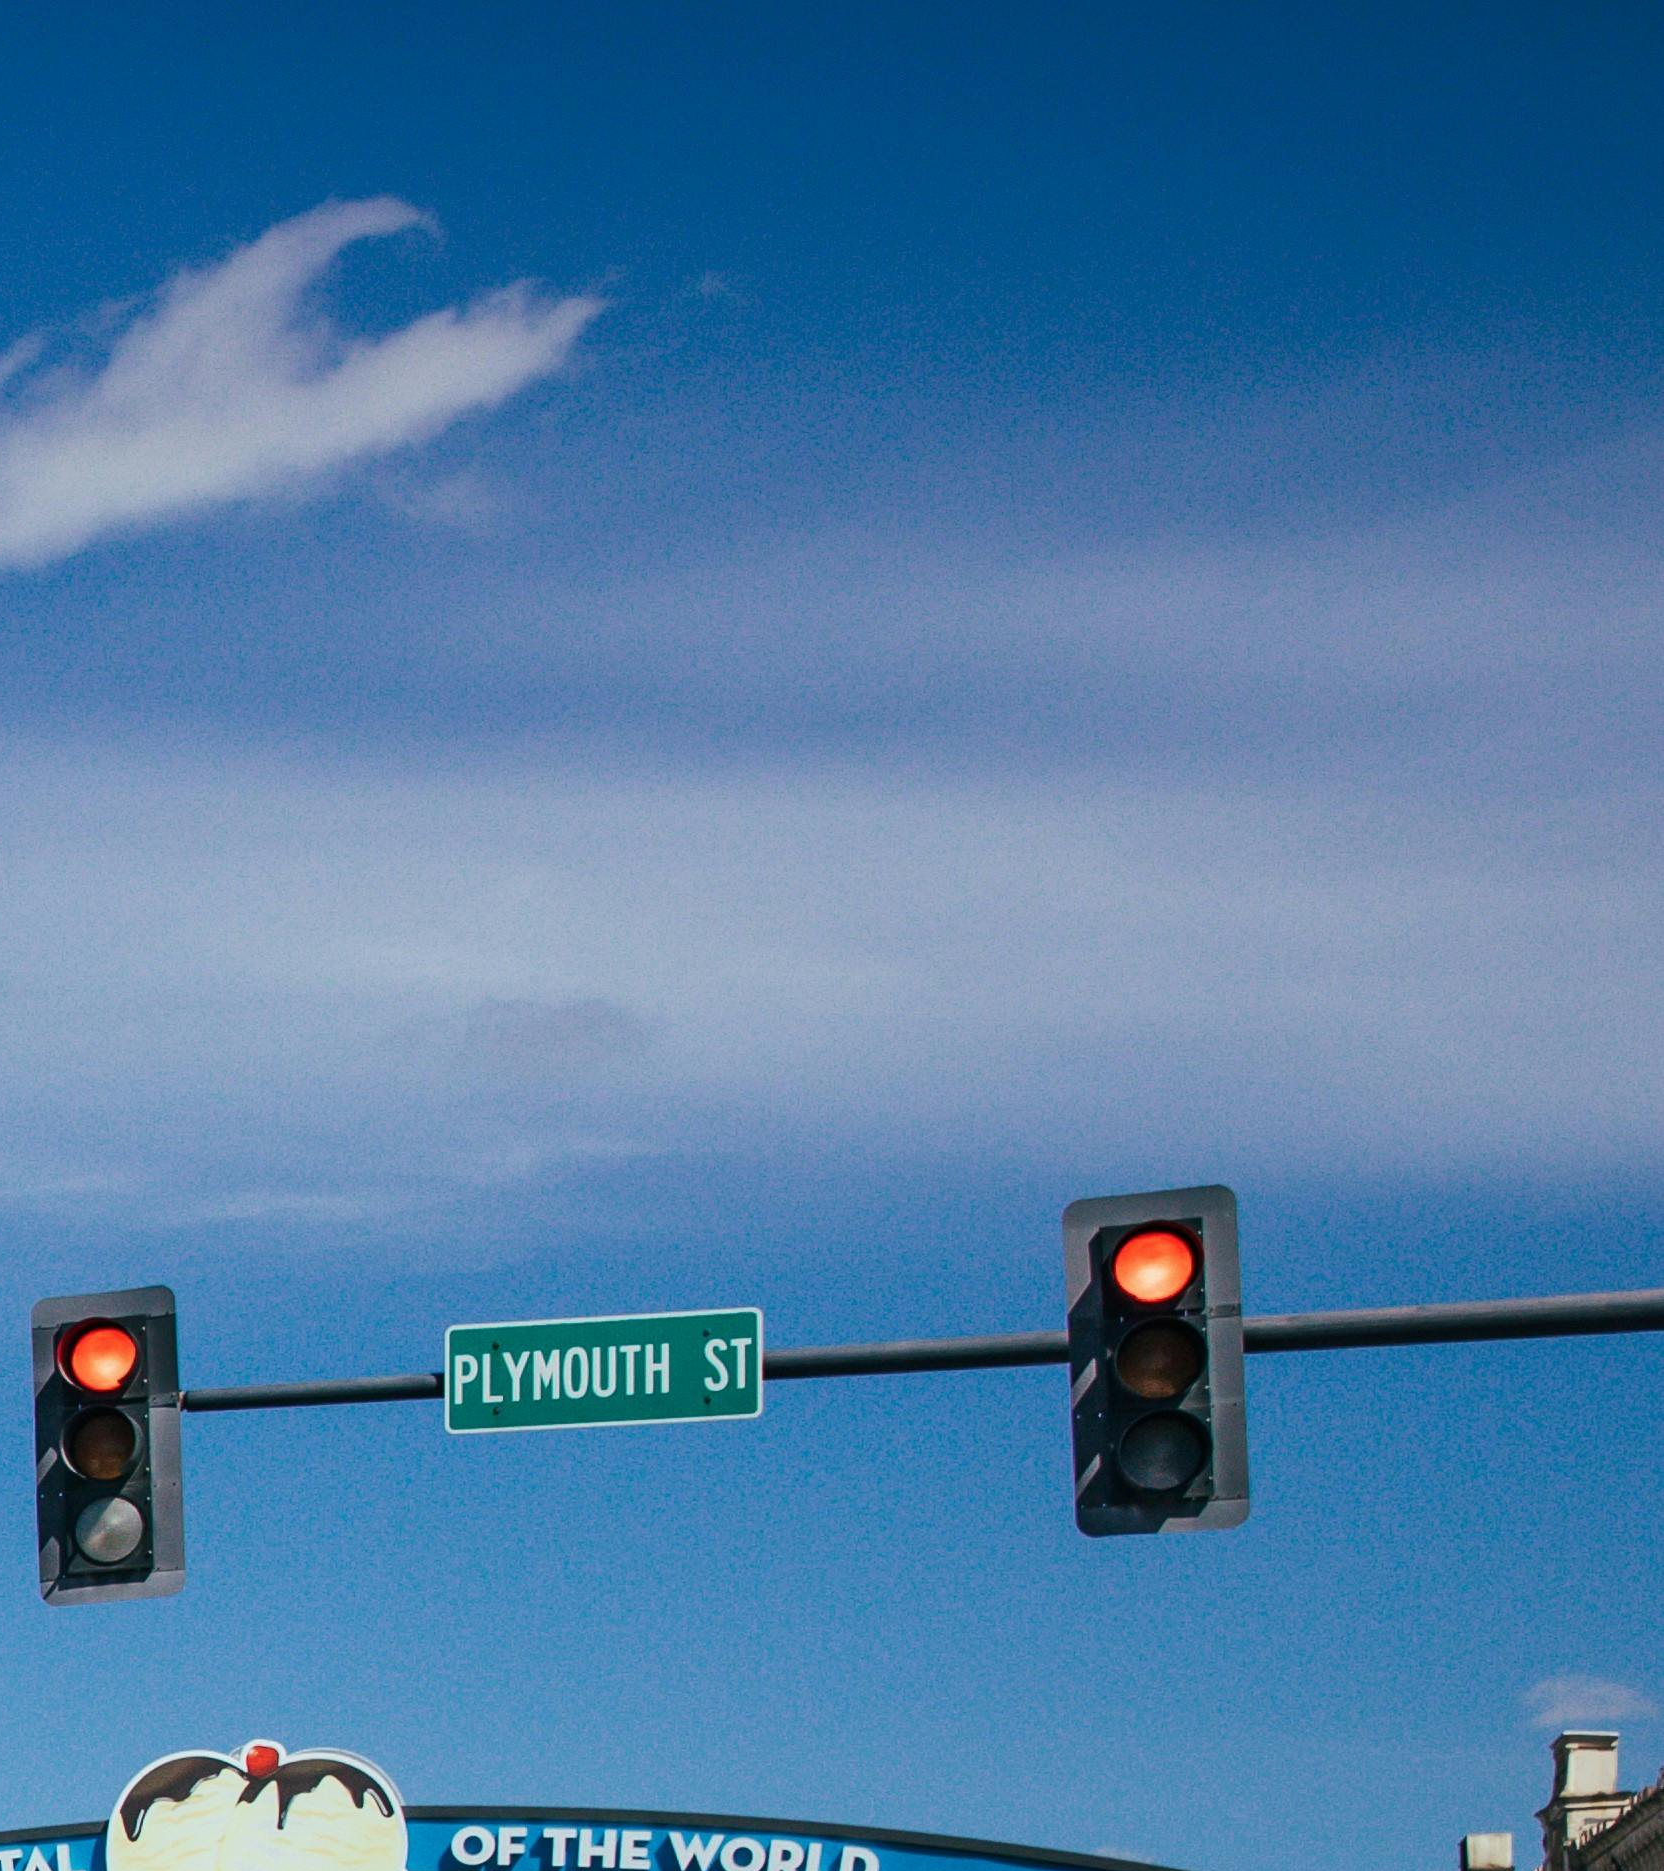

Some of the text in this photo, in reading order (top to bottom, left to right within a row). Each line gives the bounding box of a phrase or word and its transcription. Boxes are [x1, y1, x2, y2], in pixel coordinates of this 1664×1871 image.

[454, 1338, 752, 1404] PLYMOUTH ST
[451, 1826, 524, 1866] OF
[543, 1827, 651, 1870] THE
